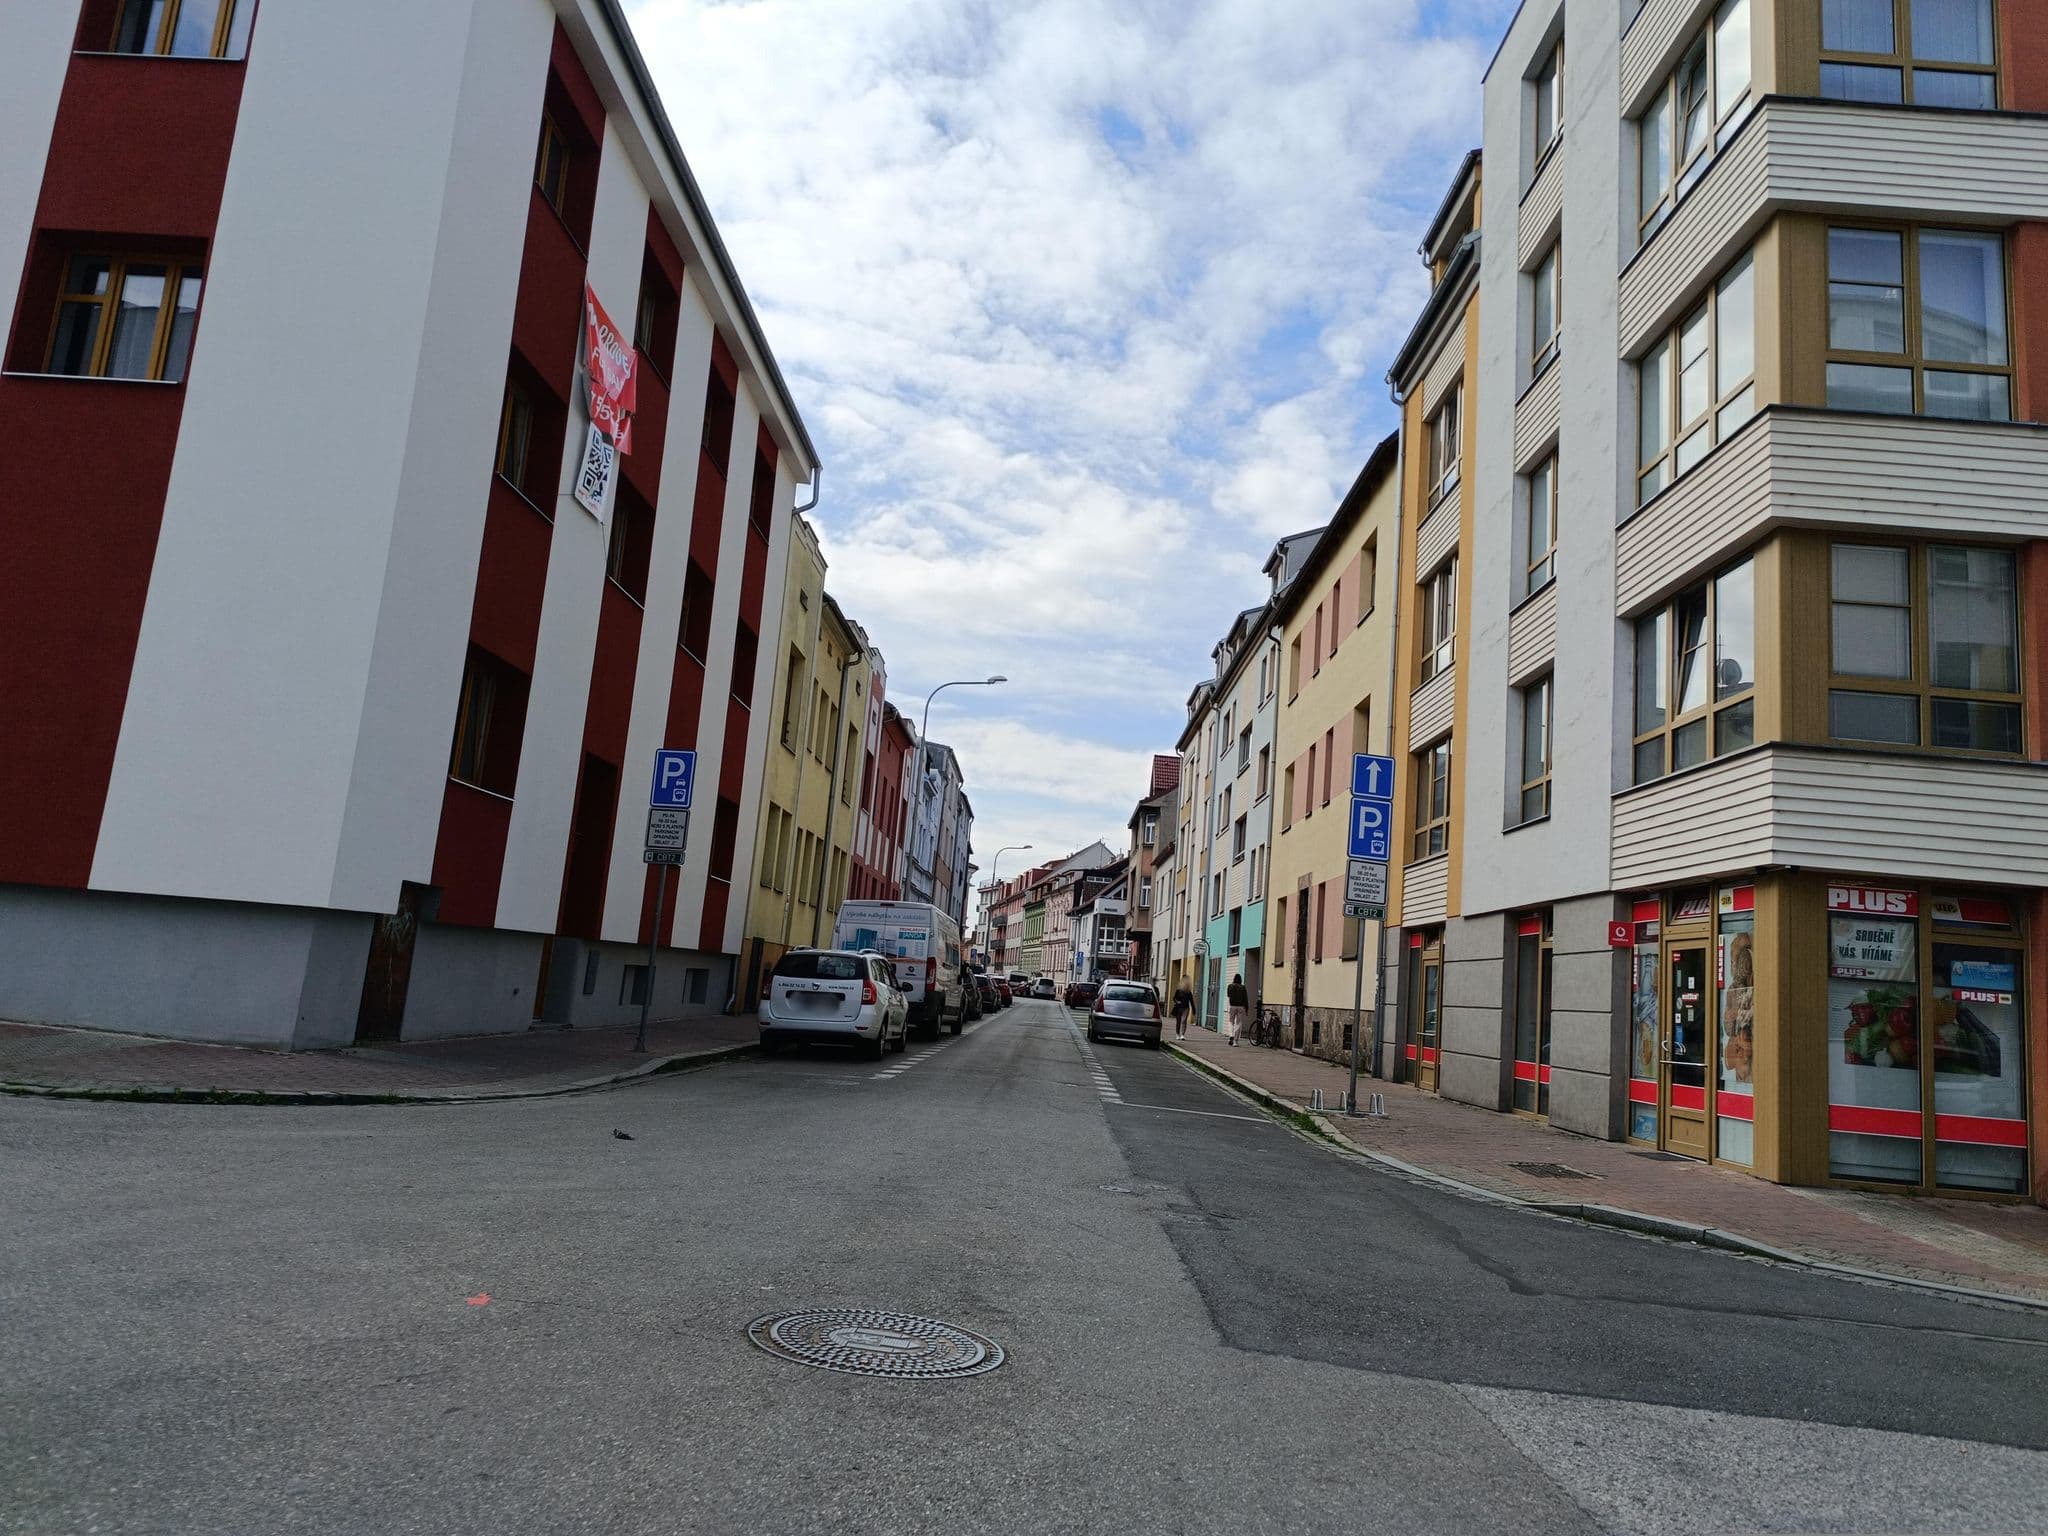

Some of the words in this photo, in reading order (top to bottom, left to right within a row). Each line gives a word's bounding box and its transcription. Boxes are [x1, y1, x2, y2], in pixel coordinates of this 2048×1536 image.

[661, 757, 686, 789] P
[1358, 806, 1383, 839] P
[1828, 887, 1907, 913] PLUS
[1855, 928, 1896, 944] SRDEČNĚ
[1838, 943, 1856, 958] VÁS
[1861, 945, 1892, 961] VÍTÁME
[1836, 967, 1864, 976] PLUS
[1961, 991, 1996, 1002] PLUS
